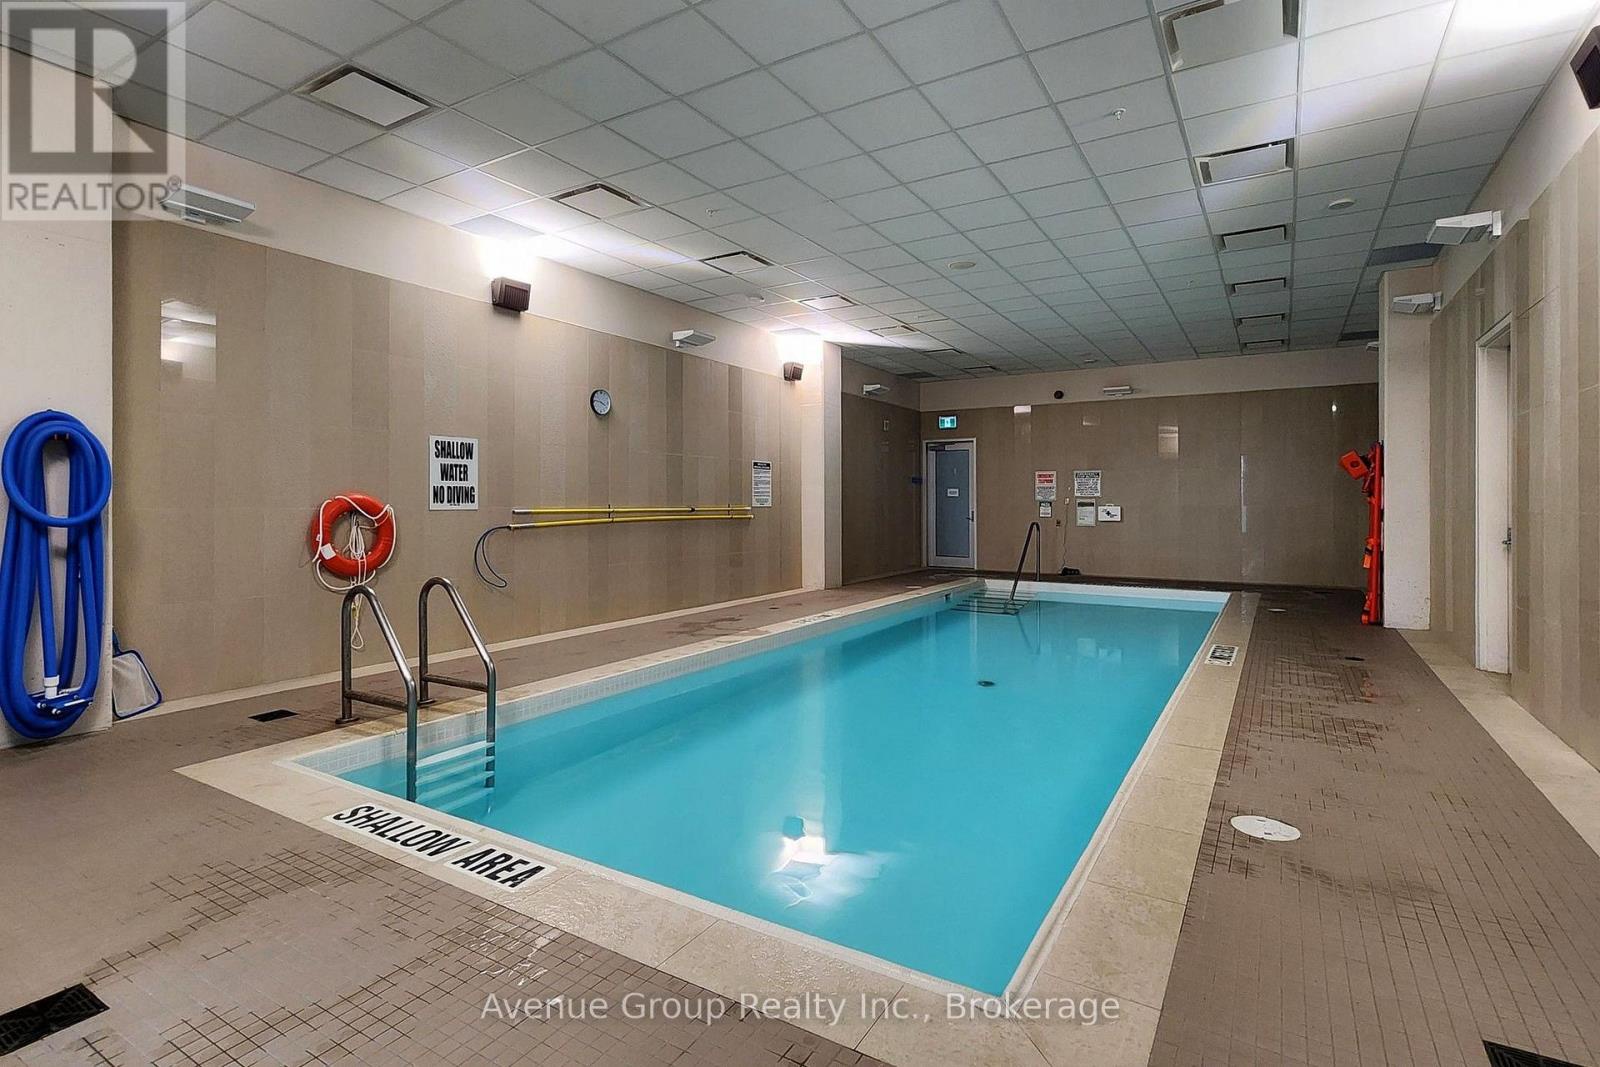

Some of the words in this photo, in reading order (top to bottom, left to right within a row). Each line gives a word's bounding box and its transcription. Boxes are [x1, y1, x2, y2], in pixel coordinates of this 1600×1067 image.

[434, 440, 474, 460] SHALLOW
[440, 463, 469, 482] WATER
[433, 485, 445, 504] NO
[447, 485, 476, 504] DIVING
[332, 804, 472, 857] SHALLOW
[450, 848, 546, 888] AREA
